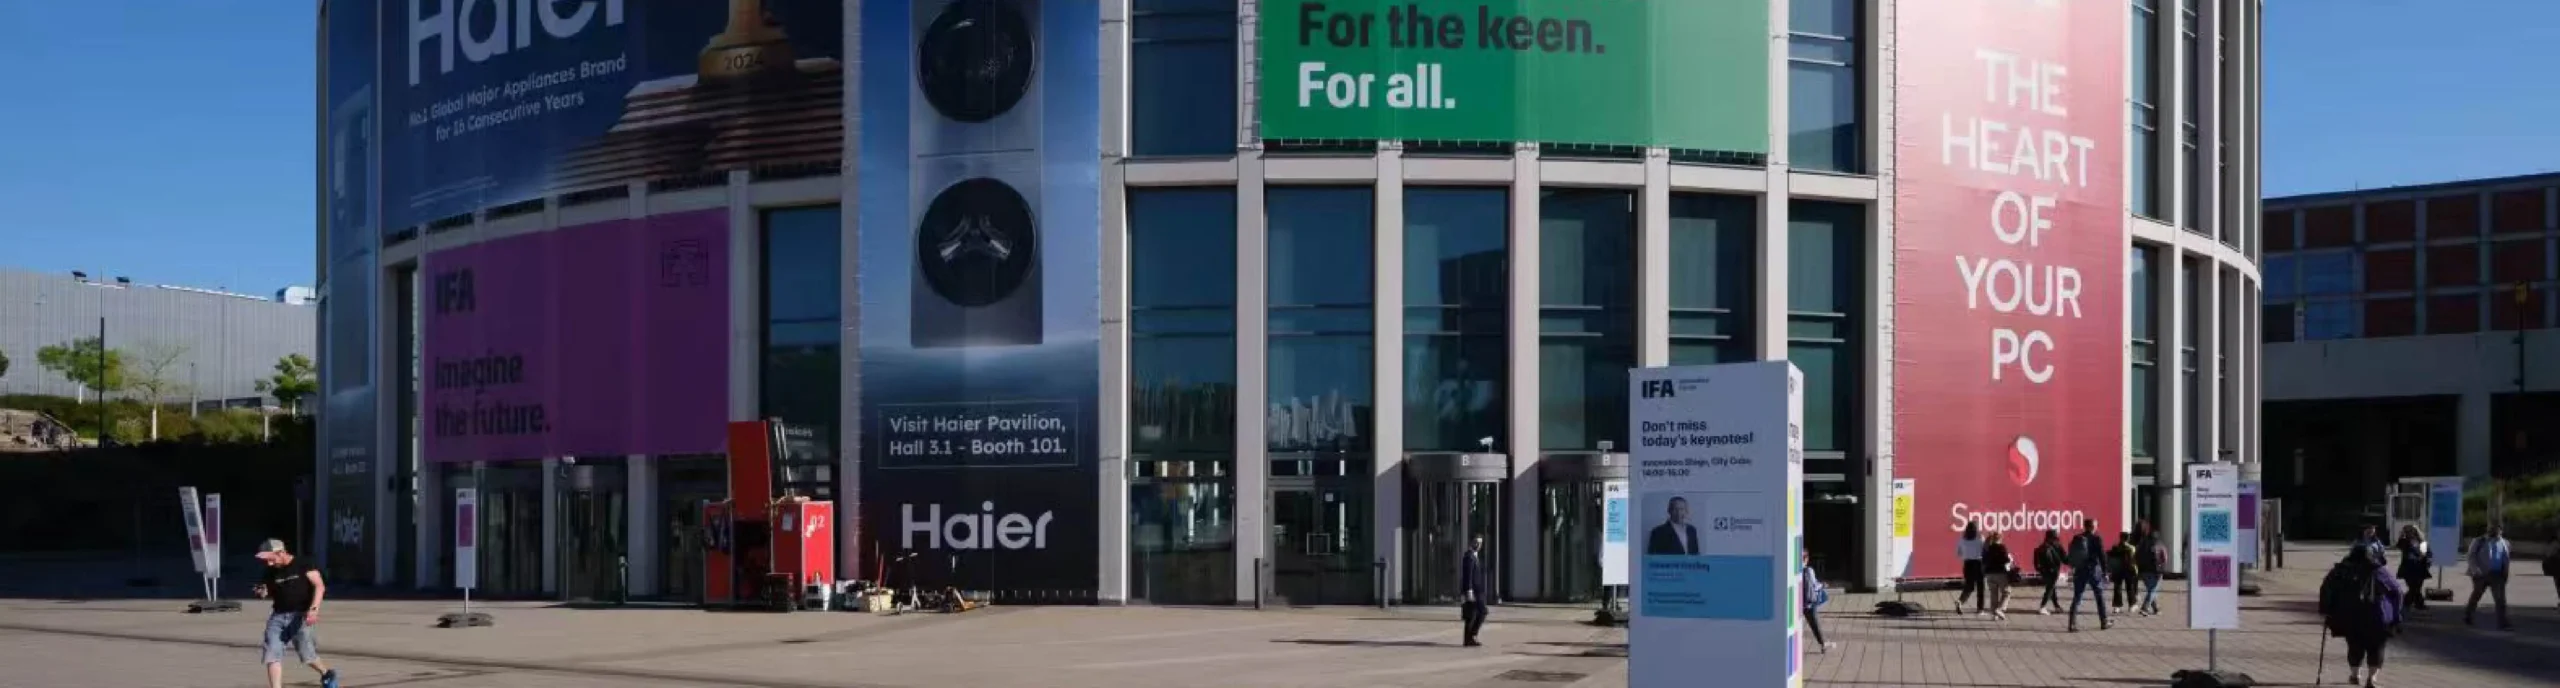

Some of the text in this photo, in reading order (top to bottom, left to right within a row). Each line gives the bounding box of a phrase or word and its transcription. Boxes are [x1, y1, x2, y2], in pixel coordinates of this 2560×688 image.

[1300, 3, 1606, 55] For the keen.
[431, 97, 463, 119] Global
[467, 85, 499, 107] Major
[503, 67, 576, 98] Appliances
[580, 52, 626, 78] Brand
[1299, 61, 1456, 109] For all.
[1975, 48, 2067, 117] THE
[436, 125, 451, 141] for
[467, 100, 541, 128] Consecutive
[545, 91, 584, 111] Years
[1942, 111, 2095, 188] HEART
[1991, 191, 2057, 247] OF
[435, 267, 476, 315] IFA
[1956, 255, 2082, 318] YOUR
[1991, 328, 2055, 384] PC
[1642, 378, 1675, 398] IFA
[435, 399, 552, 437] the future.
[890, 413, 1066, 433] Visit Haier Pavilion,
[1642, 420, 1707, 433] Don't miss
[1642, 431, 1754, 448] today's keynotes!
[889, 440, 924, 455] Hall
[929, 440, 952, 455] 3.1
[971, 438, 1025, 454] Booth
[1030, 437, 1067, 454] 101.
[2196, 469, 2212, 478] IFA
[902, 501, 1053, 549] Haier
[1952, 502, 2084, 532] Snapdragon
